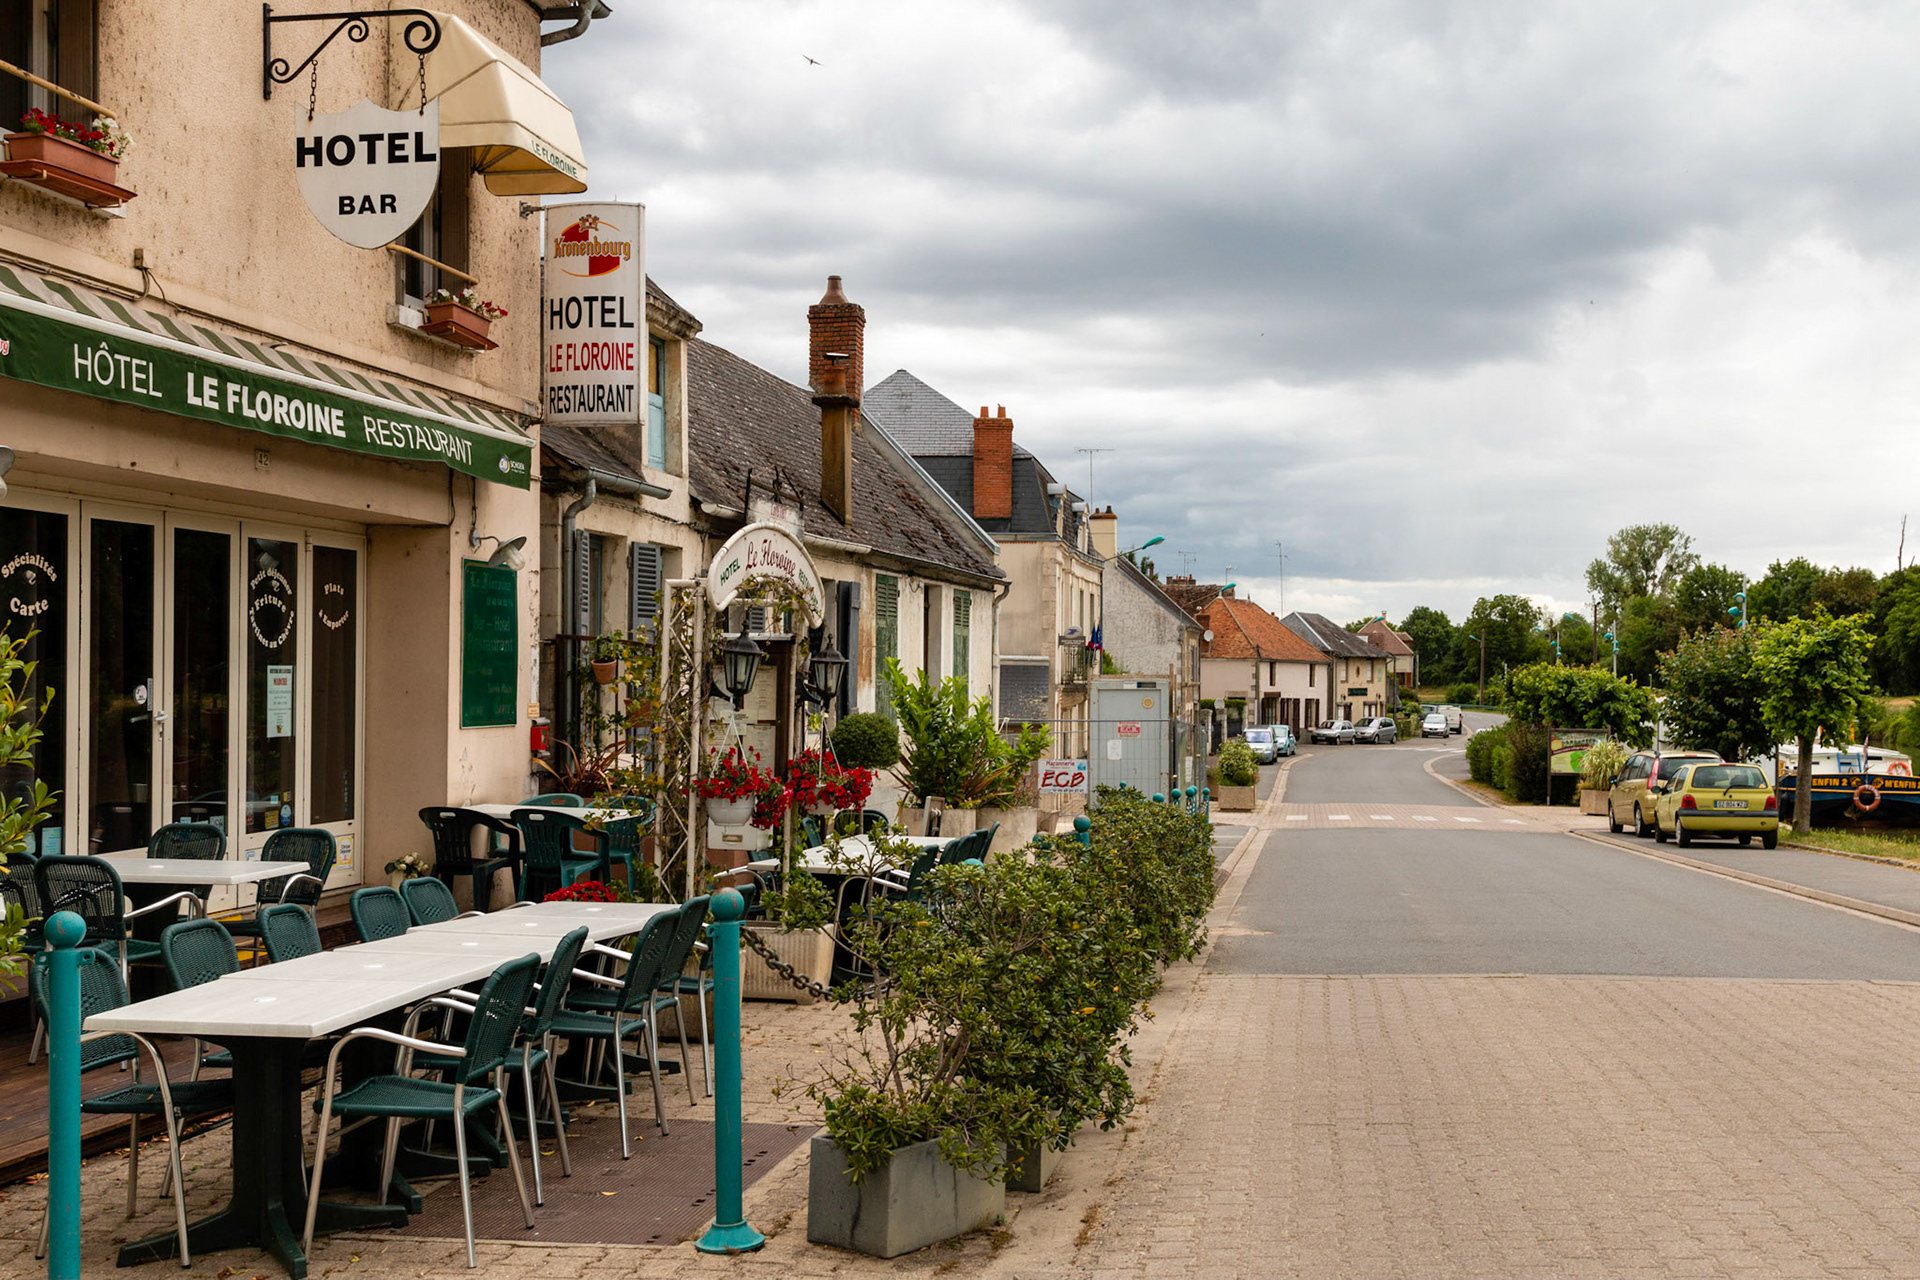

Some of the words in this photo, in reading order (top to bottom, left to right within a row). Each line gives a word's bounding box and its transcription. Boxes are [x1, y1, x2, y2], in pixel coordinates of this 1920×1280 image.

[295, 131, 437, 168] HOTEL
[530, 139, 542, 157] LE
[541, 147, 579, 180] FLOROINE
[338, 193, 397, 216] BAR
[553, 234, 631, 262] Kronenbourg
[549, 295, 635, 331] HOTEL
[549, 343, 563, 373] LE
[566, 341, 635, 372] FLOROINE
[73, 340, 163, 398] HÔTEL
[186, 371, 220, 411] LE
[226, 380, 347, 438] FLOROINE
[362, 415, 473, 466] RESTAURANT
[549, 383, 635, 415] RESTAURANT
[1, 551, 58, 582] Spécialités
[745, 540, 758, 571] Le
[759, 538, 797, 578] Floroine
[250, 569, 266, 590] Petit
[720, 557, 741, 586] HOTEL
[324, 582, 345, 596] Plats
[9, 596, 49, 617] Carte
[254, 593, 287, 613] Friture
[322, 610, 349, 631] Emporter
[269, 641, 278, 649] au
[1045, 760, 1076, 768] Maçonnerie
[1041, 770, 1085, 788] ECB
[1811, 777, 1840, 787] ENFIN
[1841, 778, 1848, 787] 2
[1884, 779, 1917, 789] M'ENFIN
